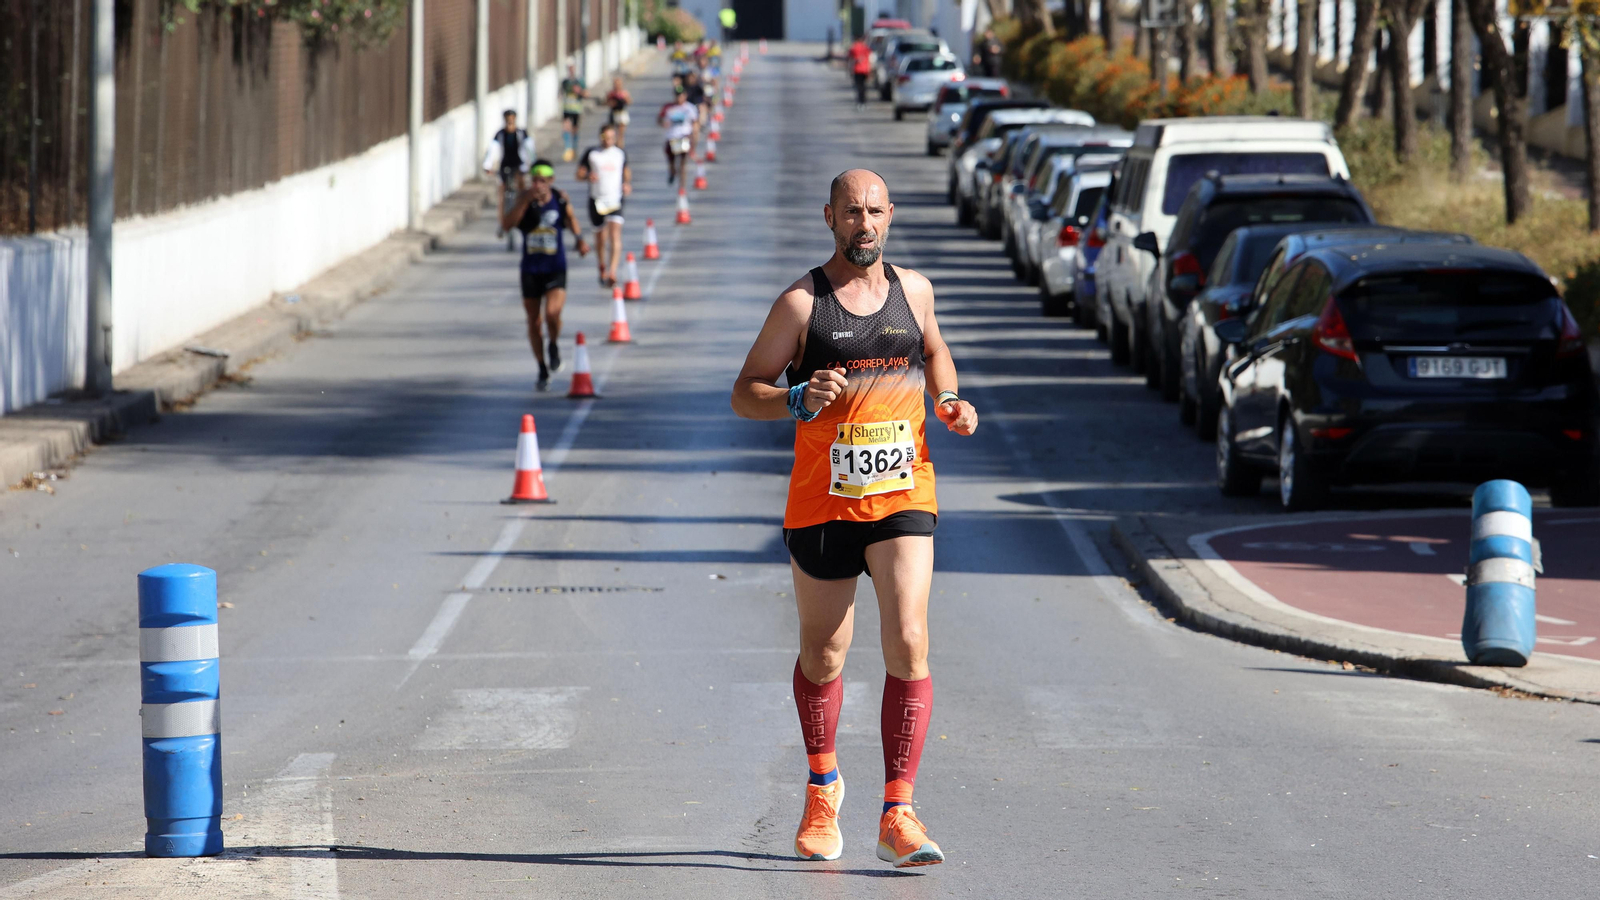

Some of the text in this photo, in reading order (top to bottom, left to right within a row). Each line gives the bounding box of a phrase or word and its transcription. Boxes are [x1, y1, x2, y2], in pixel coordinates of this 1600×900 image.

[846, 356, 909, 370] CORREPLAYAS
[1418, 359, 1463, 375] 9169
[854, 425, 892, 441] Sherry
[844, 448, 903, 475] 1362
